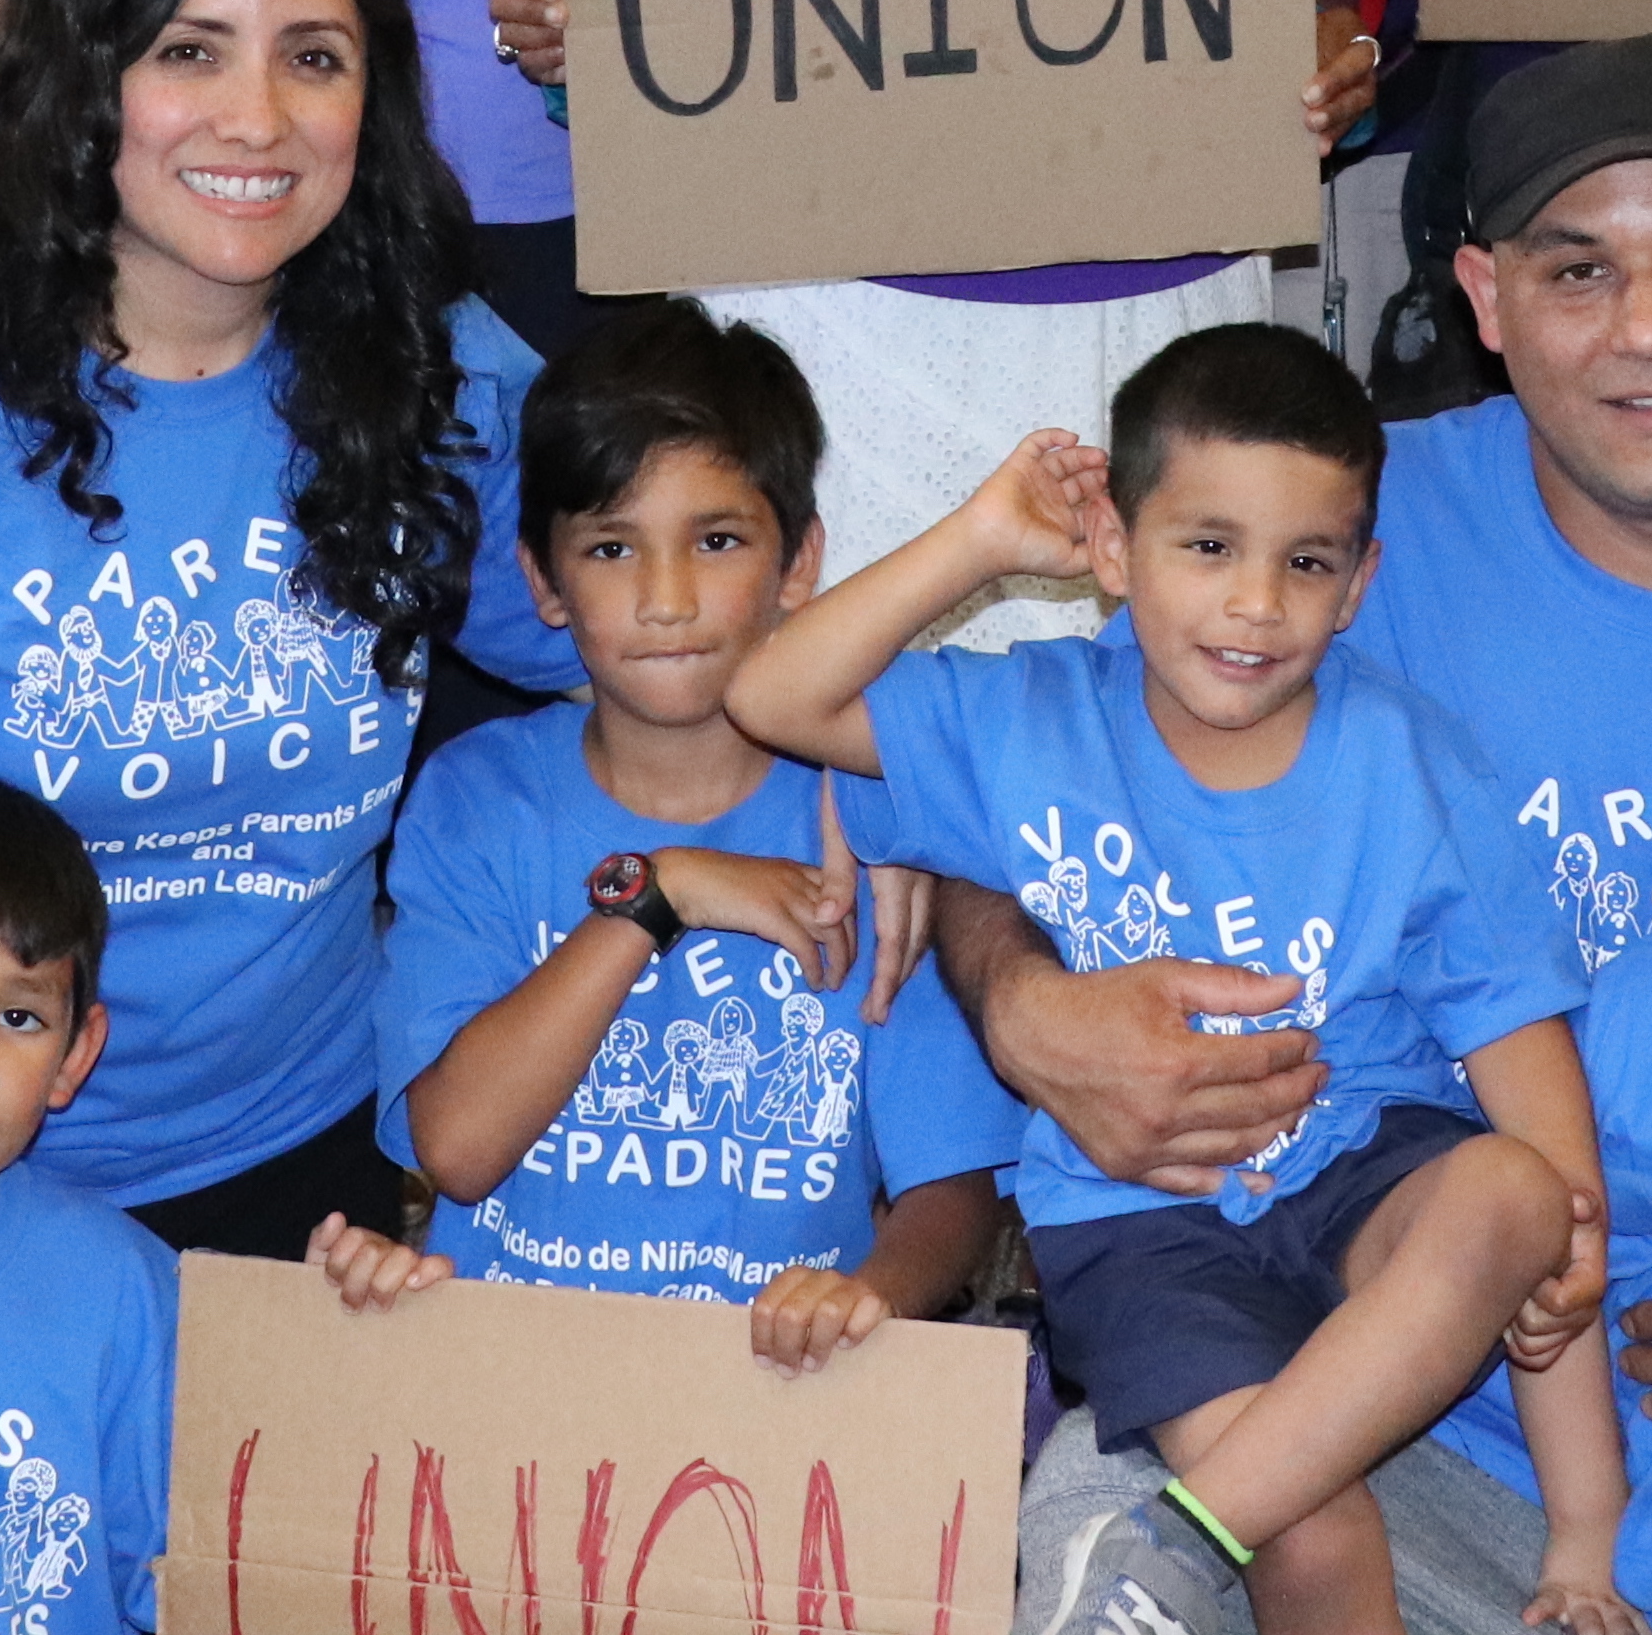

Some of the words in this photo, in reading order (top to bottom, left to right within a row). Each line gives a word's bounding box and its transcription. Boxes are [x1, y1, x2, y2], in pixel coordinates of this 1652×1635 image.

[135, 823, 234, 852] Keeps
[241, 804, 355, 834] Parents
[191, 841, 255, 862] and
[101, 876, 207, 906] hildren
[588, 1237, 630, 1271] de
[641, 1240, 729, 1272] Niños
